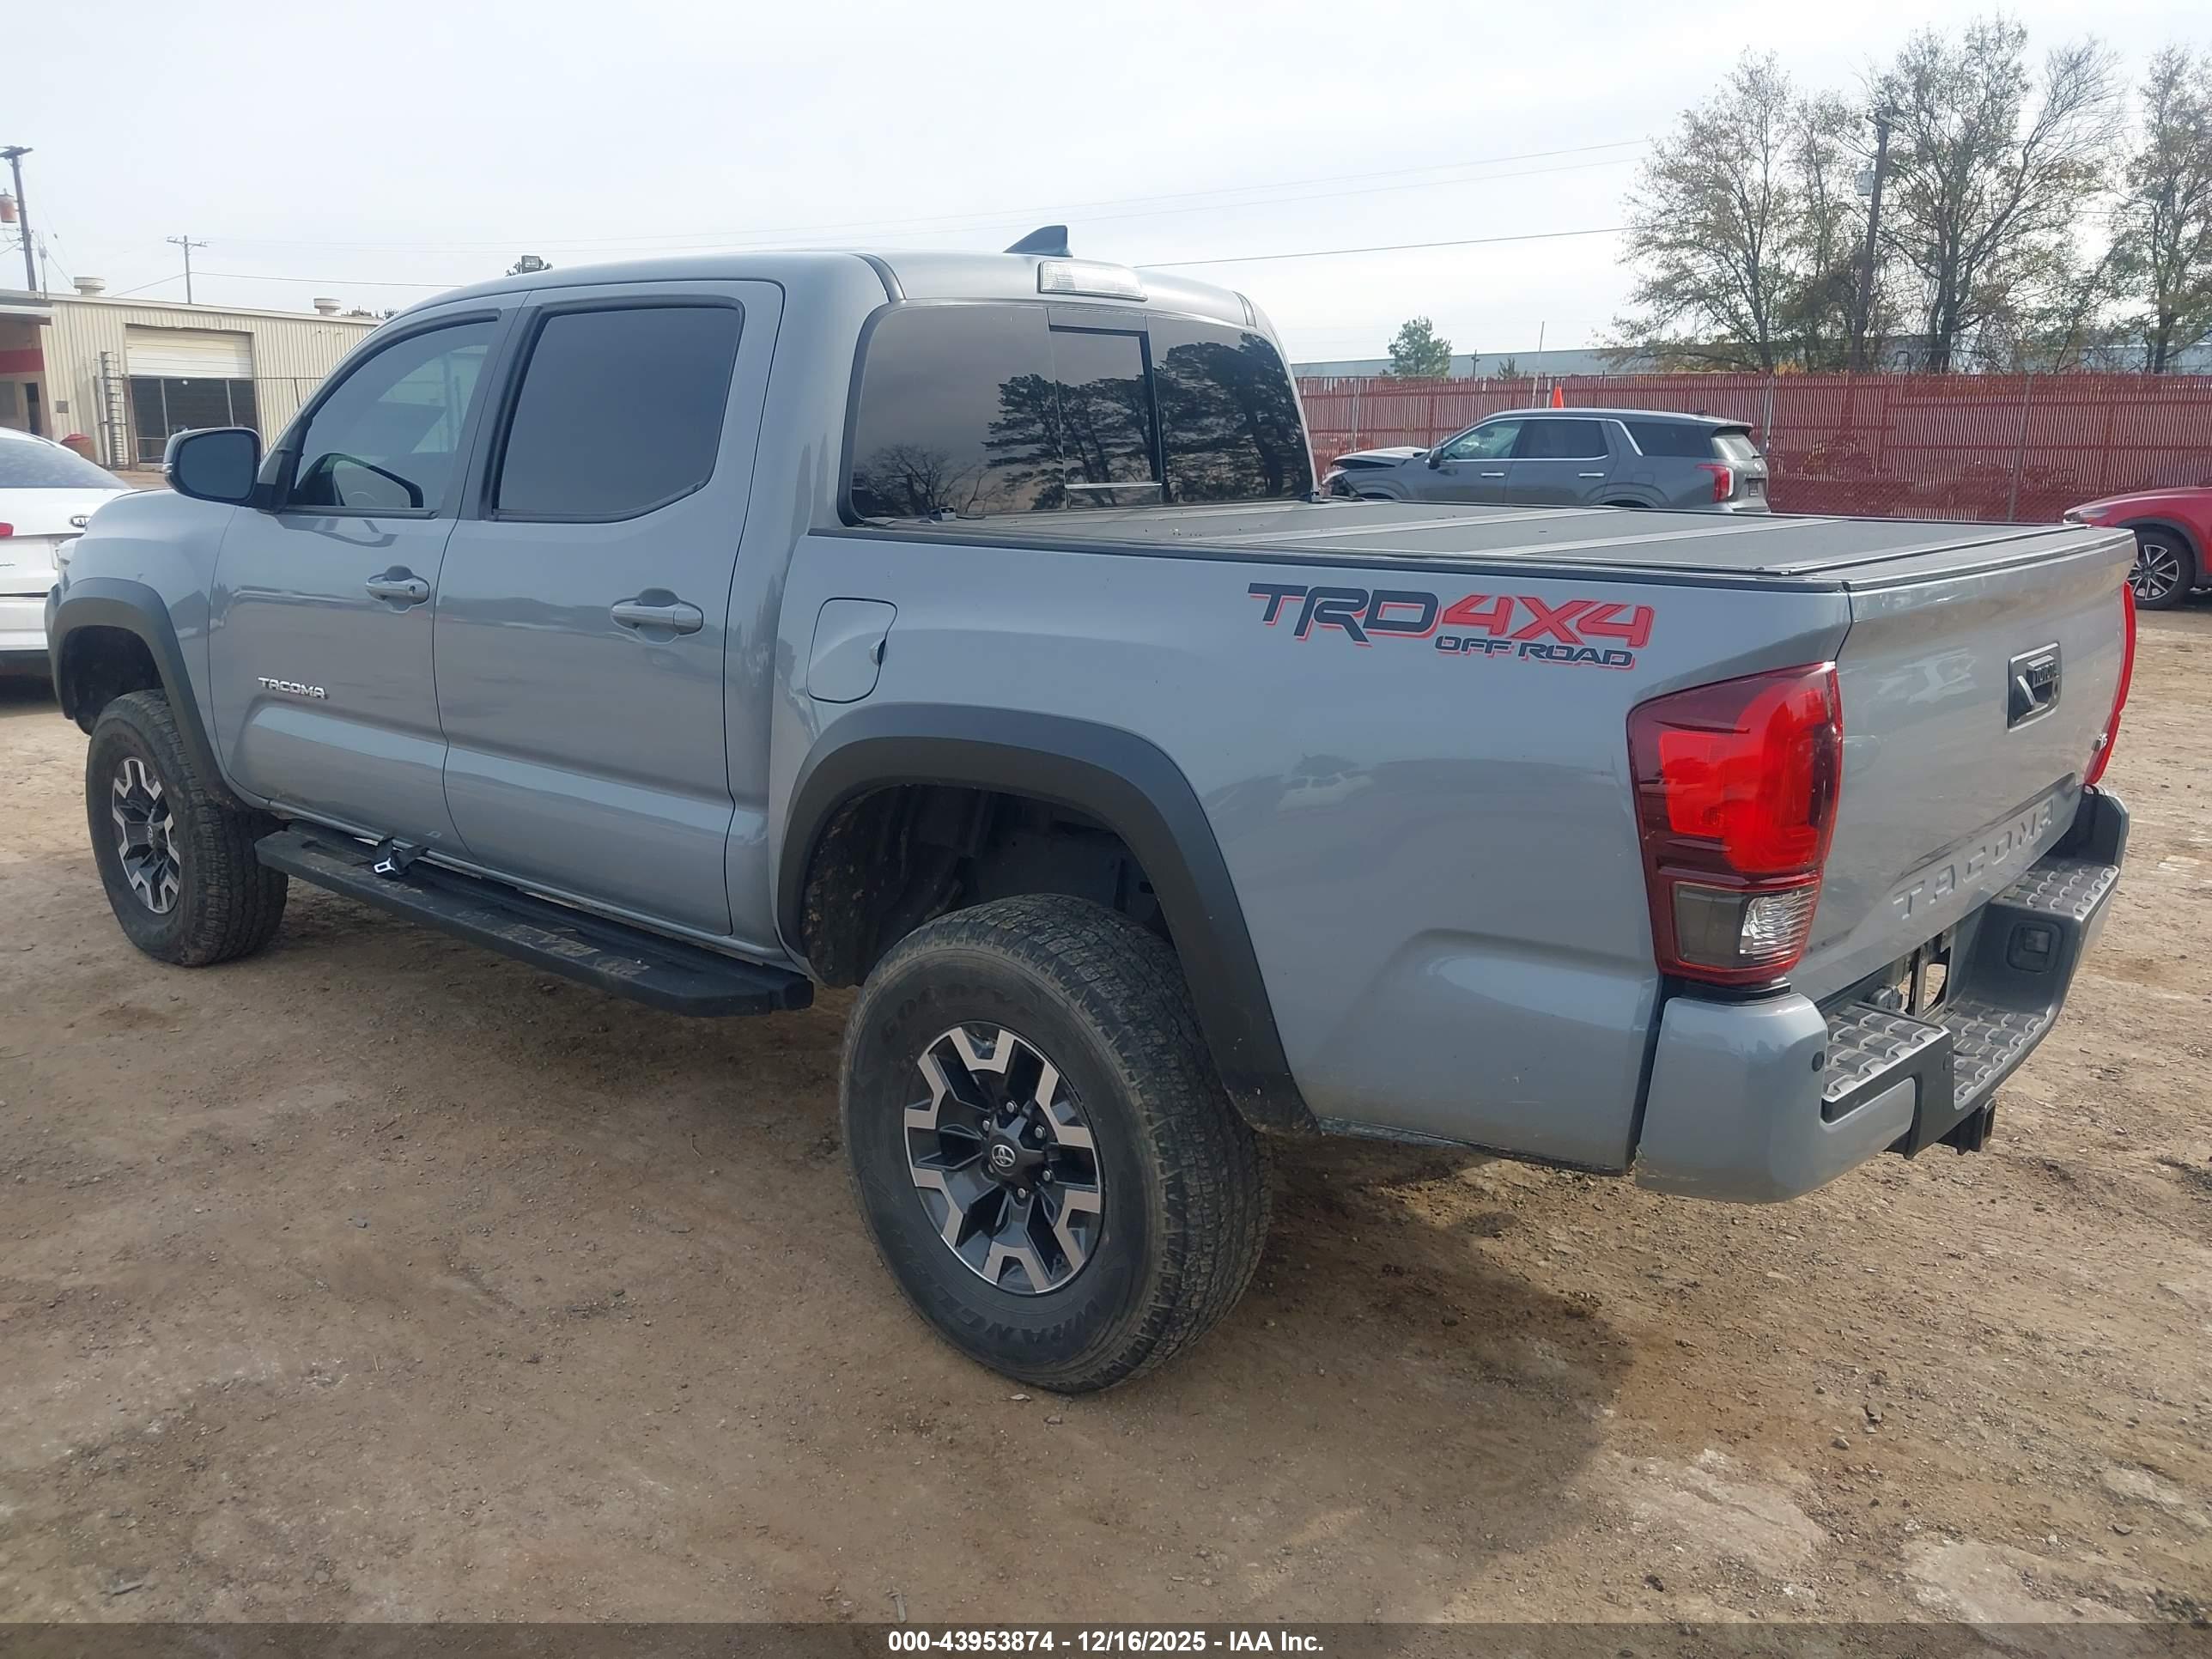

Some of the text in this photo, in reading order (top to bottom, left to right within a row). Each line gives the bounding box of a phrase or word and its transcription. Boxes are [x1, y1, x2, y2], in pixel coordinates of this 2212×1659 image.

[1248, 582, 1656, 649] TRD 4X4
[1434, 634, 1636, 671] OFF ROAD
[257, 676, 327, 700] TACOMA
[1892, 798, 2055, 921] TACOMA
